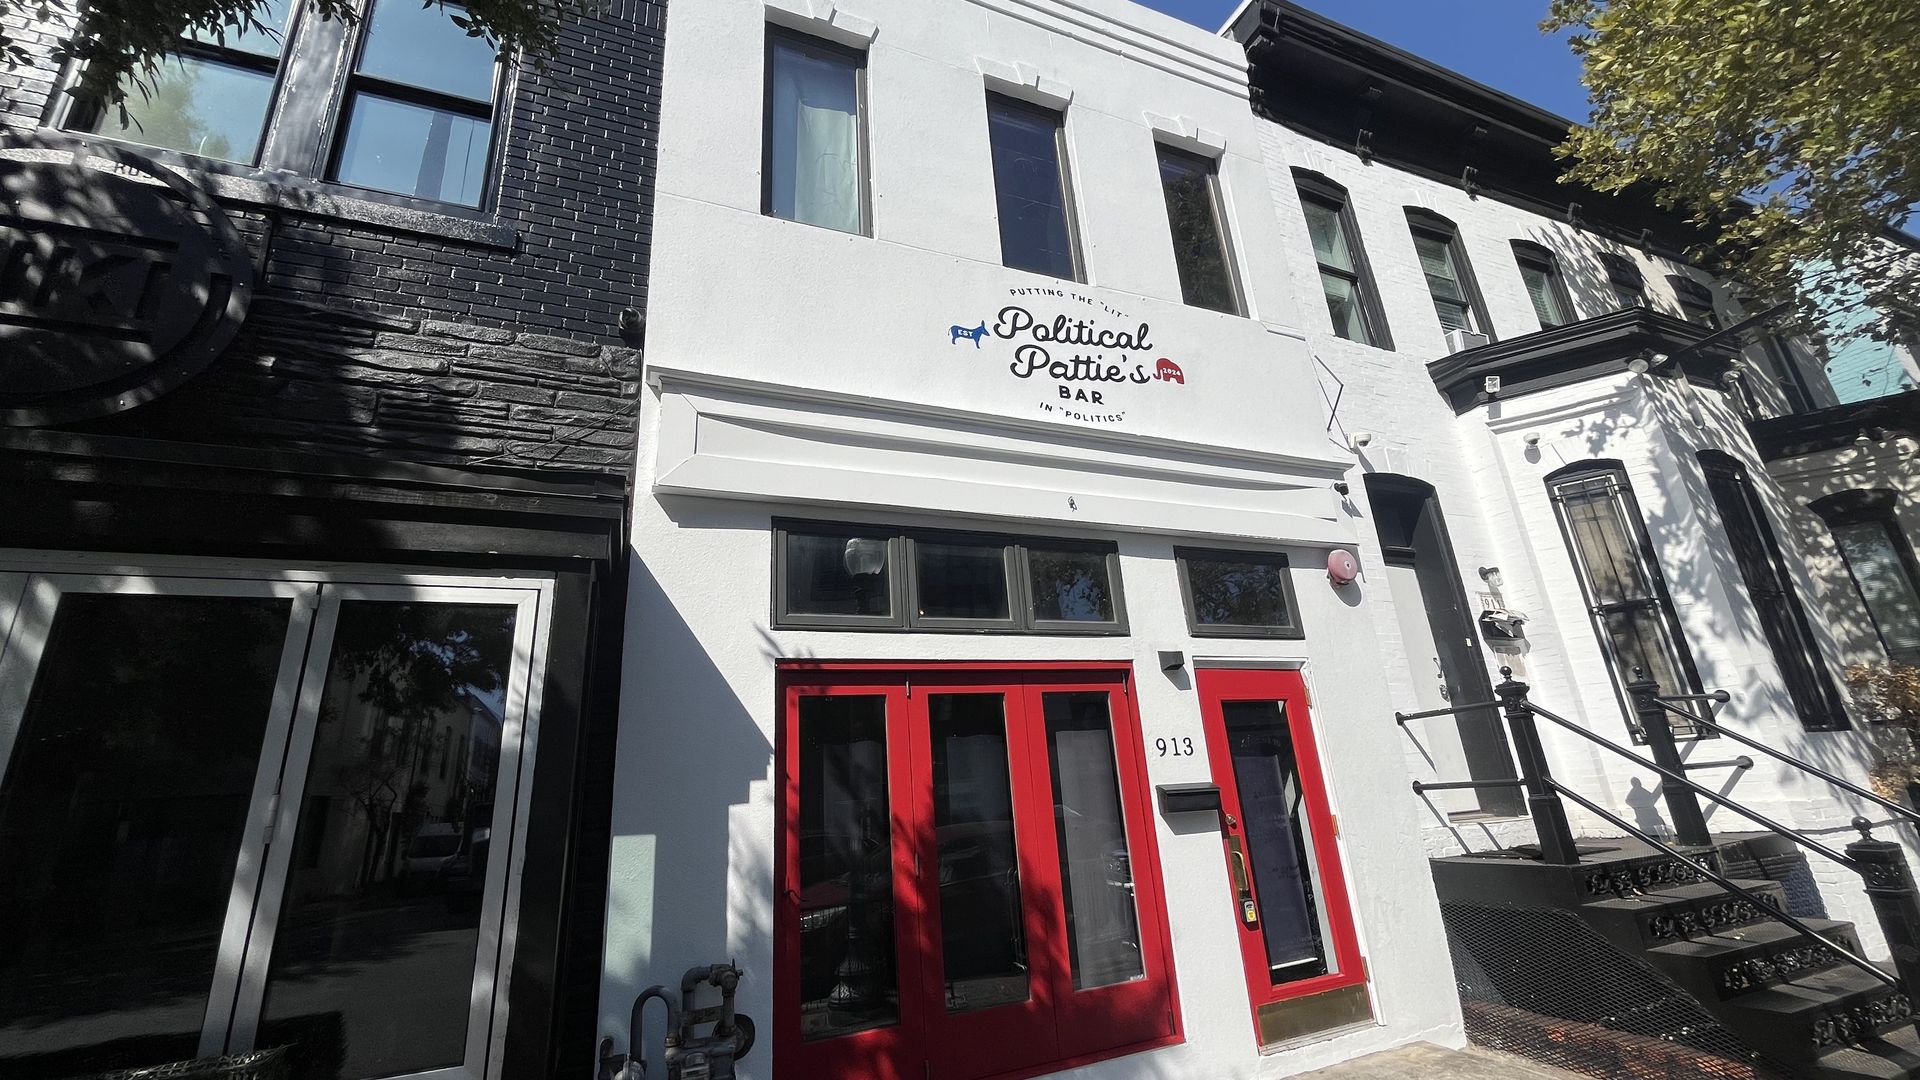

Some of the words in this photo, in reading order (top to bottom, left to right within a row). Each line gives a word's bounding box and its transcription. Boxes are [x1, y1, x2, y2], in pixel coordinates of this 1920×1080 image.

[1009, 288, 1064, 298] PUTTING
[1071, 292, 1093, 305] THE
[1100, 301, 1129, 318] "LIT"
[957, 329, 973, 337] EST
[993, 306, 1153, 351] Political
[1009, 344, 1151, 384] Pattie's
[1162, 367, 1181, 376] 2024
[1058, 385, 1105, 405] BAR
[1039, 401, 1053, 412] IN
[1059, 407, 1126, 423] "POLITICS"
[1155, 737, 1194, 757] 913
